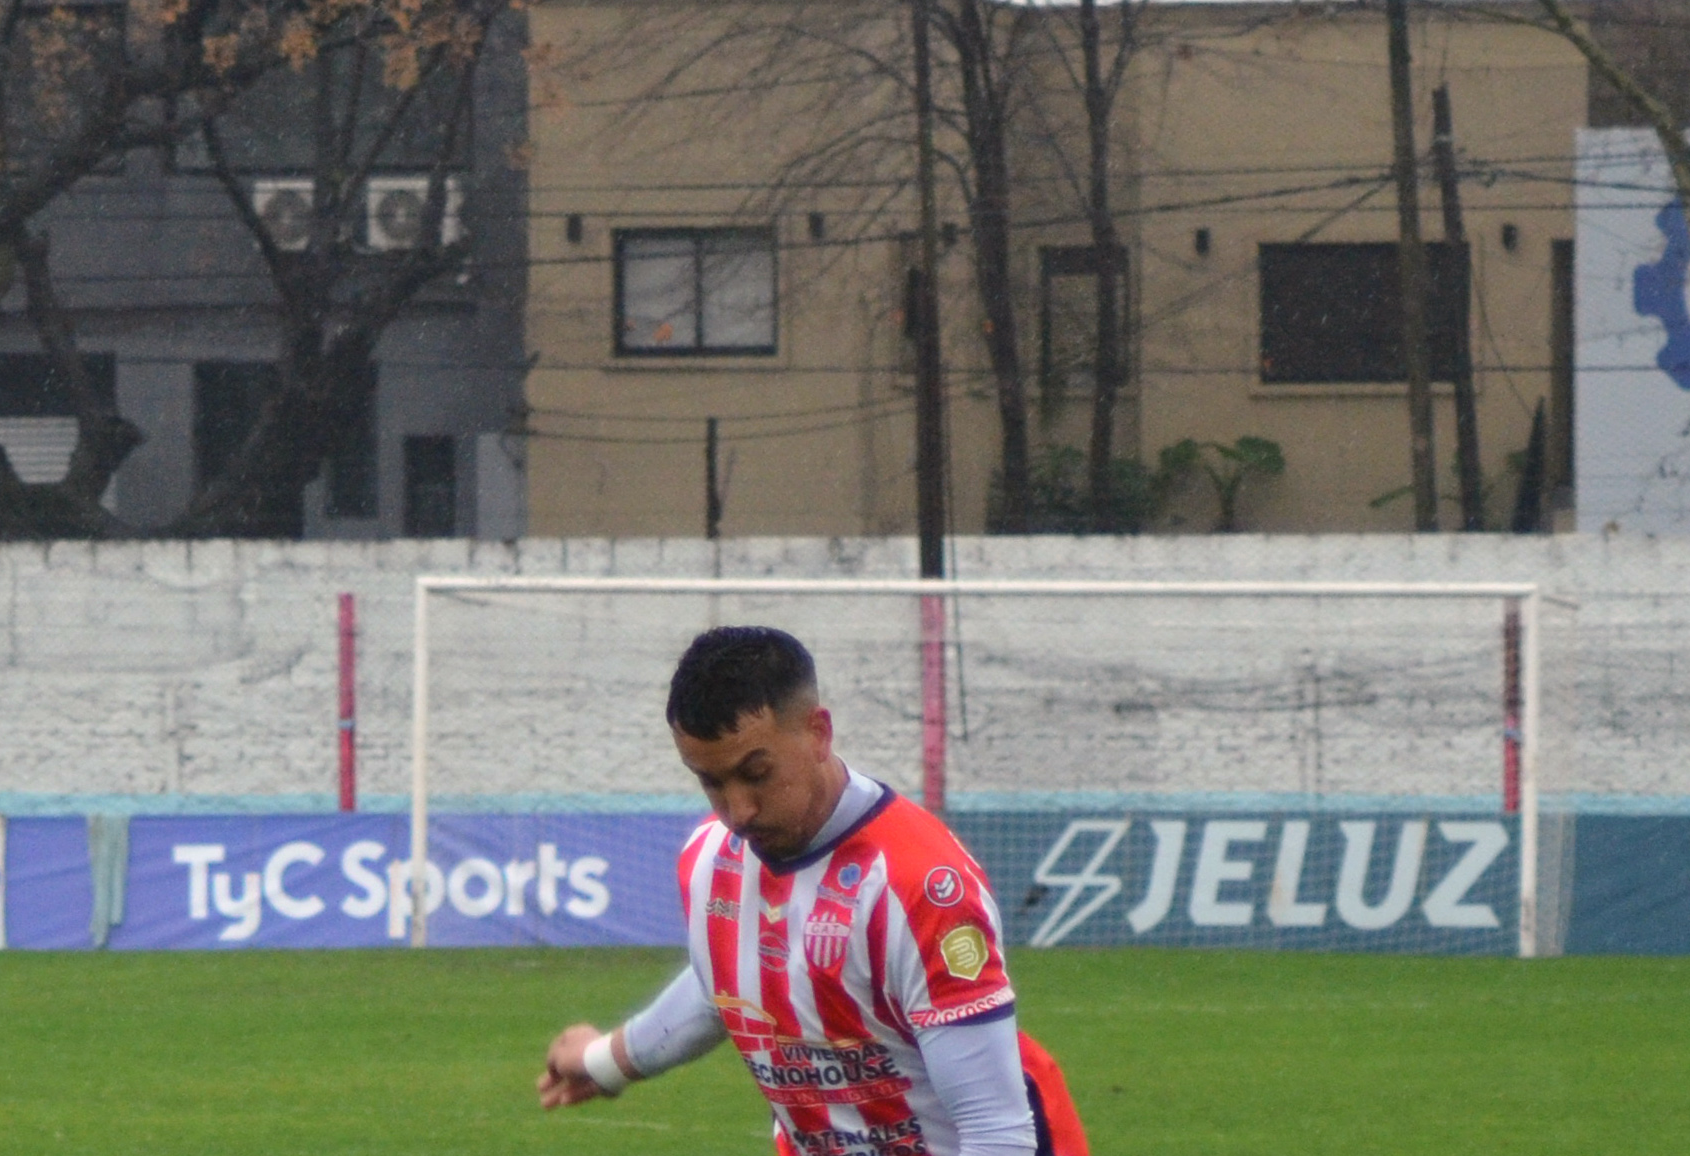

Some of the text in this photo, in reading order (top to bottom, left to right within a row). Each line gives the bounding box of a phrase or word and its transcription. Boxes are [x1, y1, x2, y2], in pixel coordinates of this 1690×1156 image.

[172, 840, 611, 942] TyC Sports
[1126, 819, 1511, 933] JELUZ
